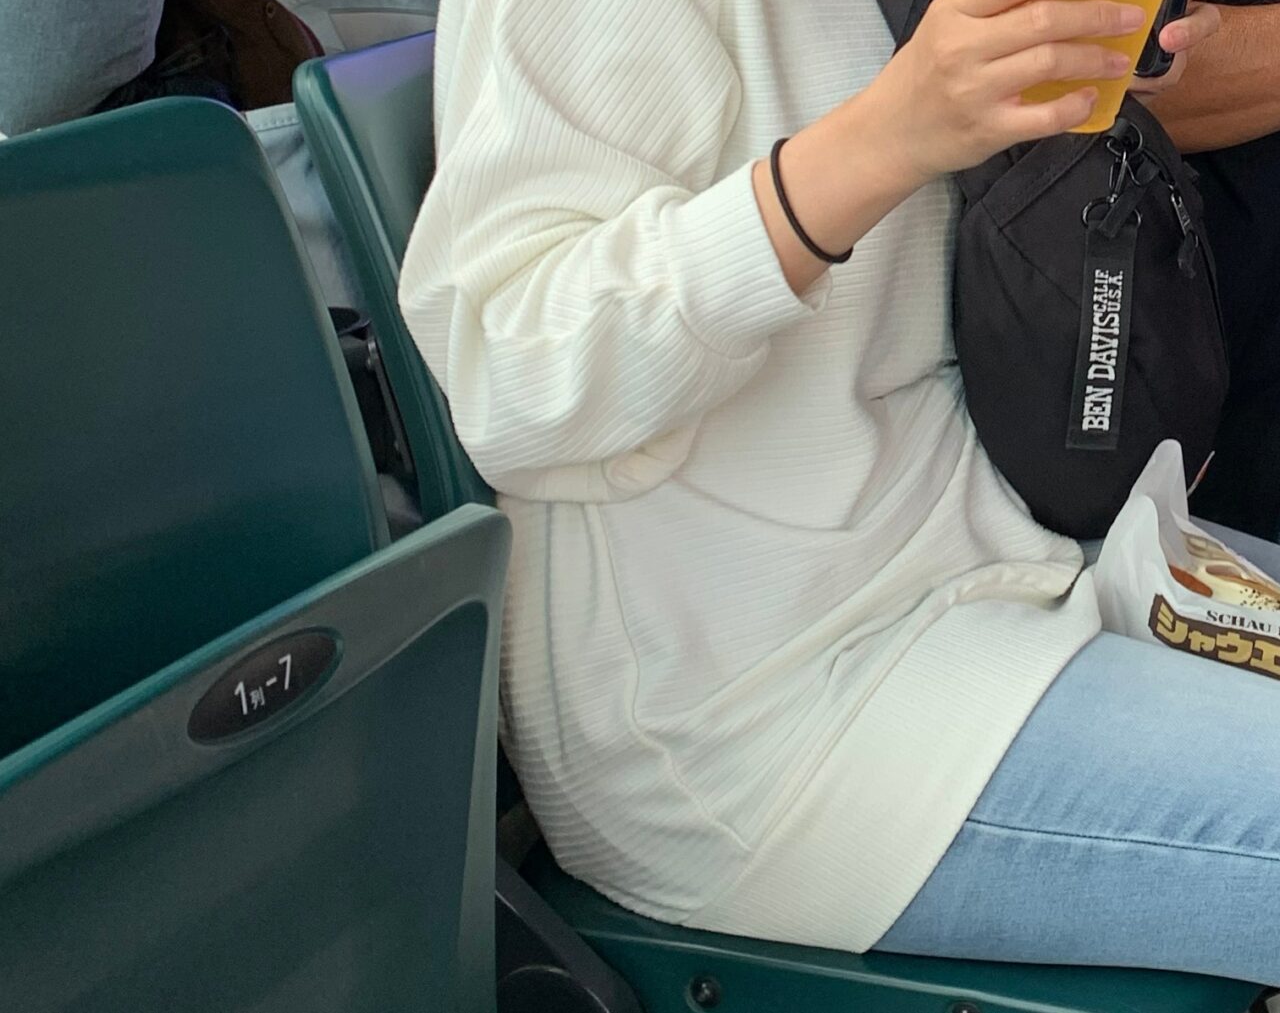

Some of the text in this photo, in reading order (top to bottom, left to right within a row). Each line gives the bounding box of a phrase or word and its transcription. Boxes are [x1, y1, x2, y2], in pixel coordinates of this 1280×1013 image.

[1082, 312, 1120, 431] BEN DAVIS
[1206, 609, 1272, 634] SCHAU
